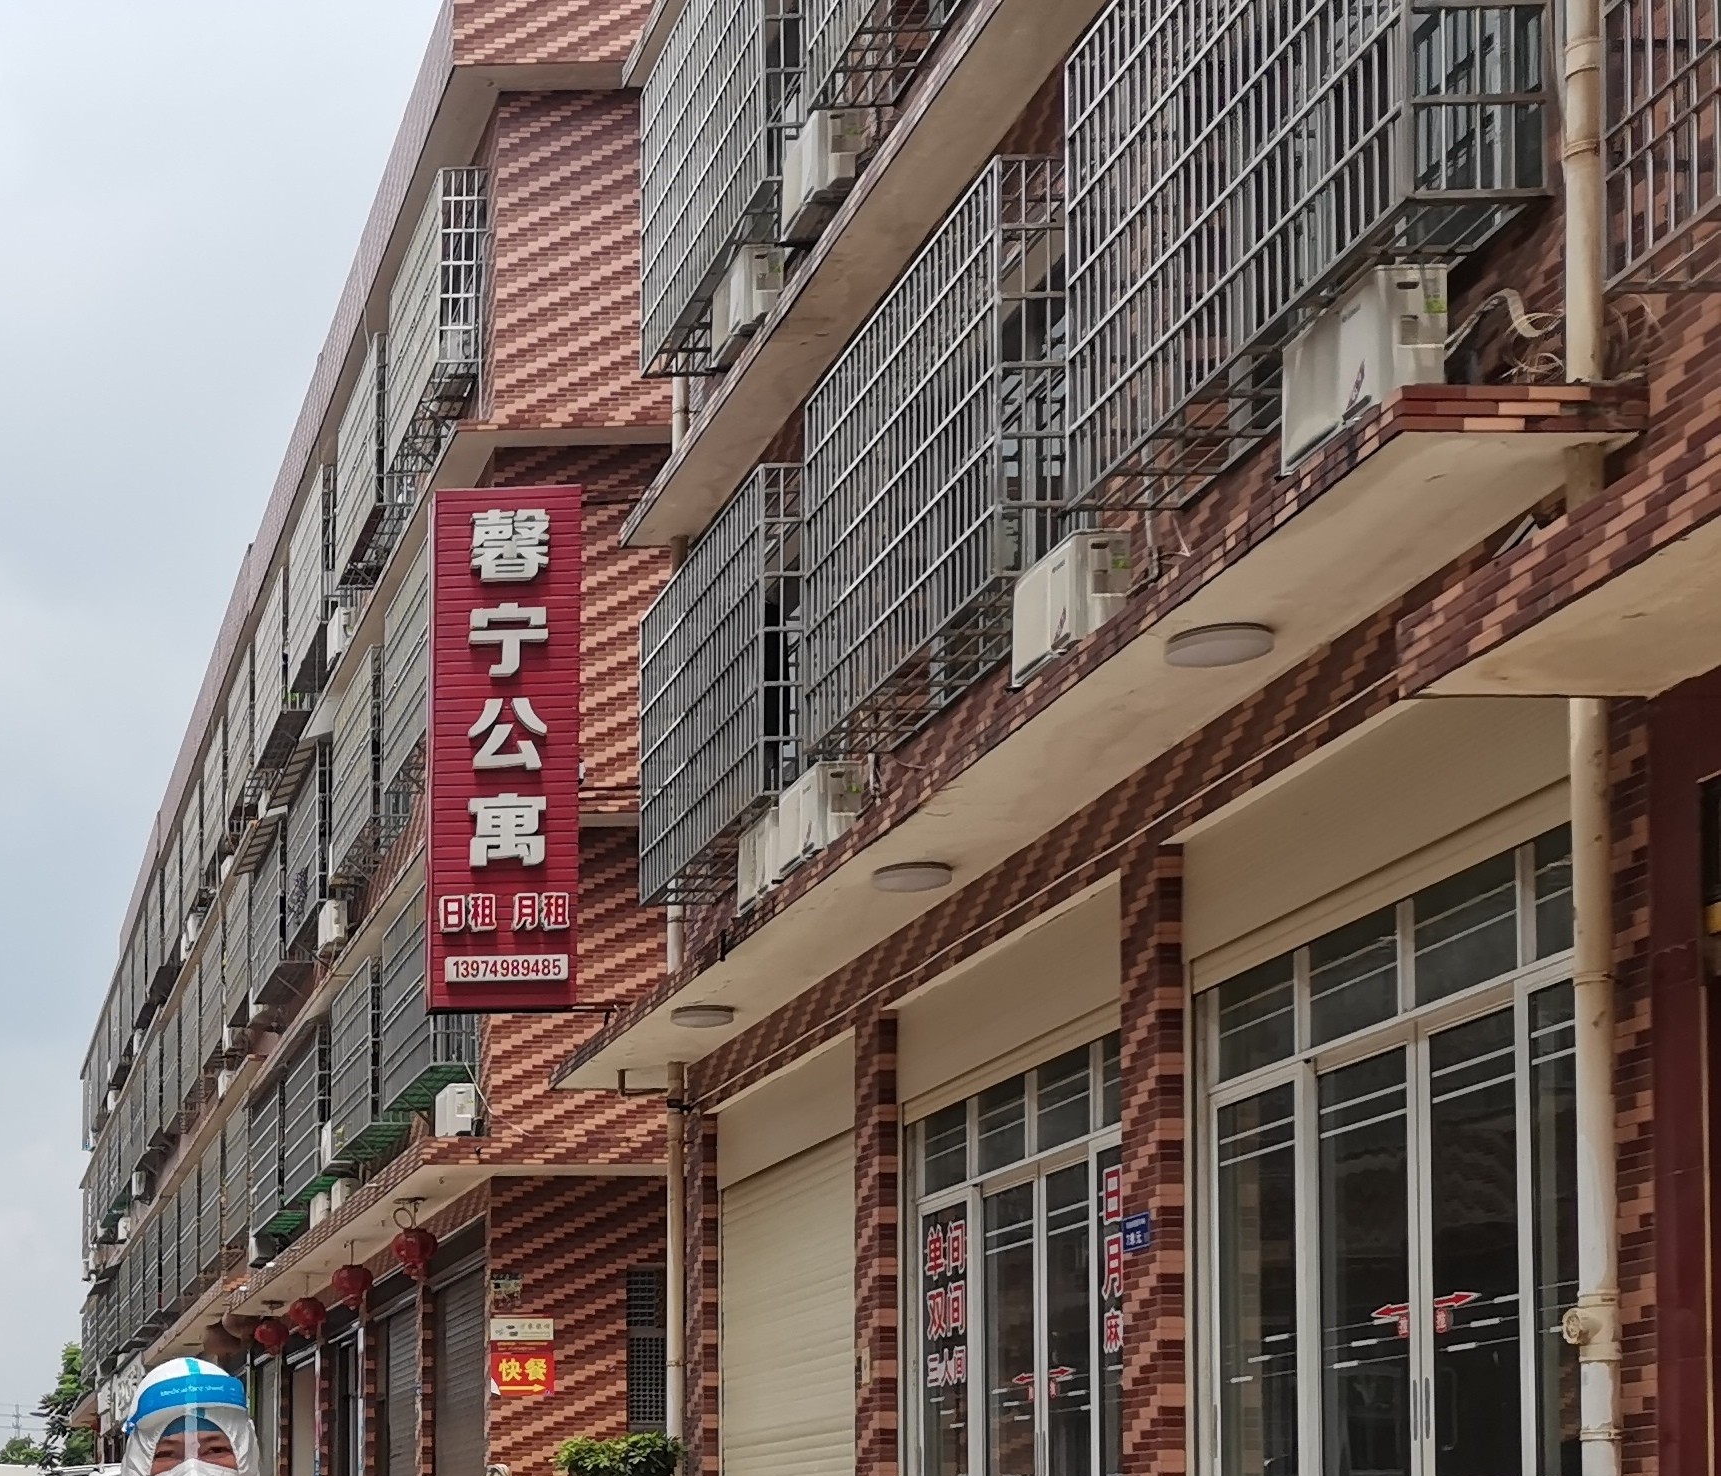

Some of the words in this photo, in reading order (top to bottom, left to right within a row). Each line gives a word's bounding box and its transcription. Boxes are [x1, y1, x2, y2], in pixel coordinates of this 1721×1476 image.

[468, 508, 550, 867] 馨宁公寓
[439, 893, 497, 933] 日租
[512, 892, 570, 931] 月租
[452, 958, 562, 979] 13974989485
[924, 1220, 966, 1281] 单间
[926, 1280, 966, 1341] 双间
[498, 1358, 547, 1382] 快餐
[926, 1345, 967, 1388] 三人间
